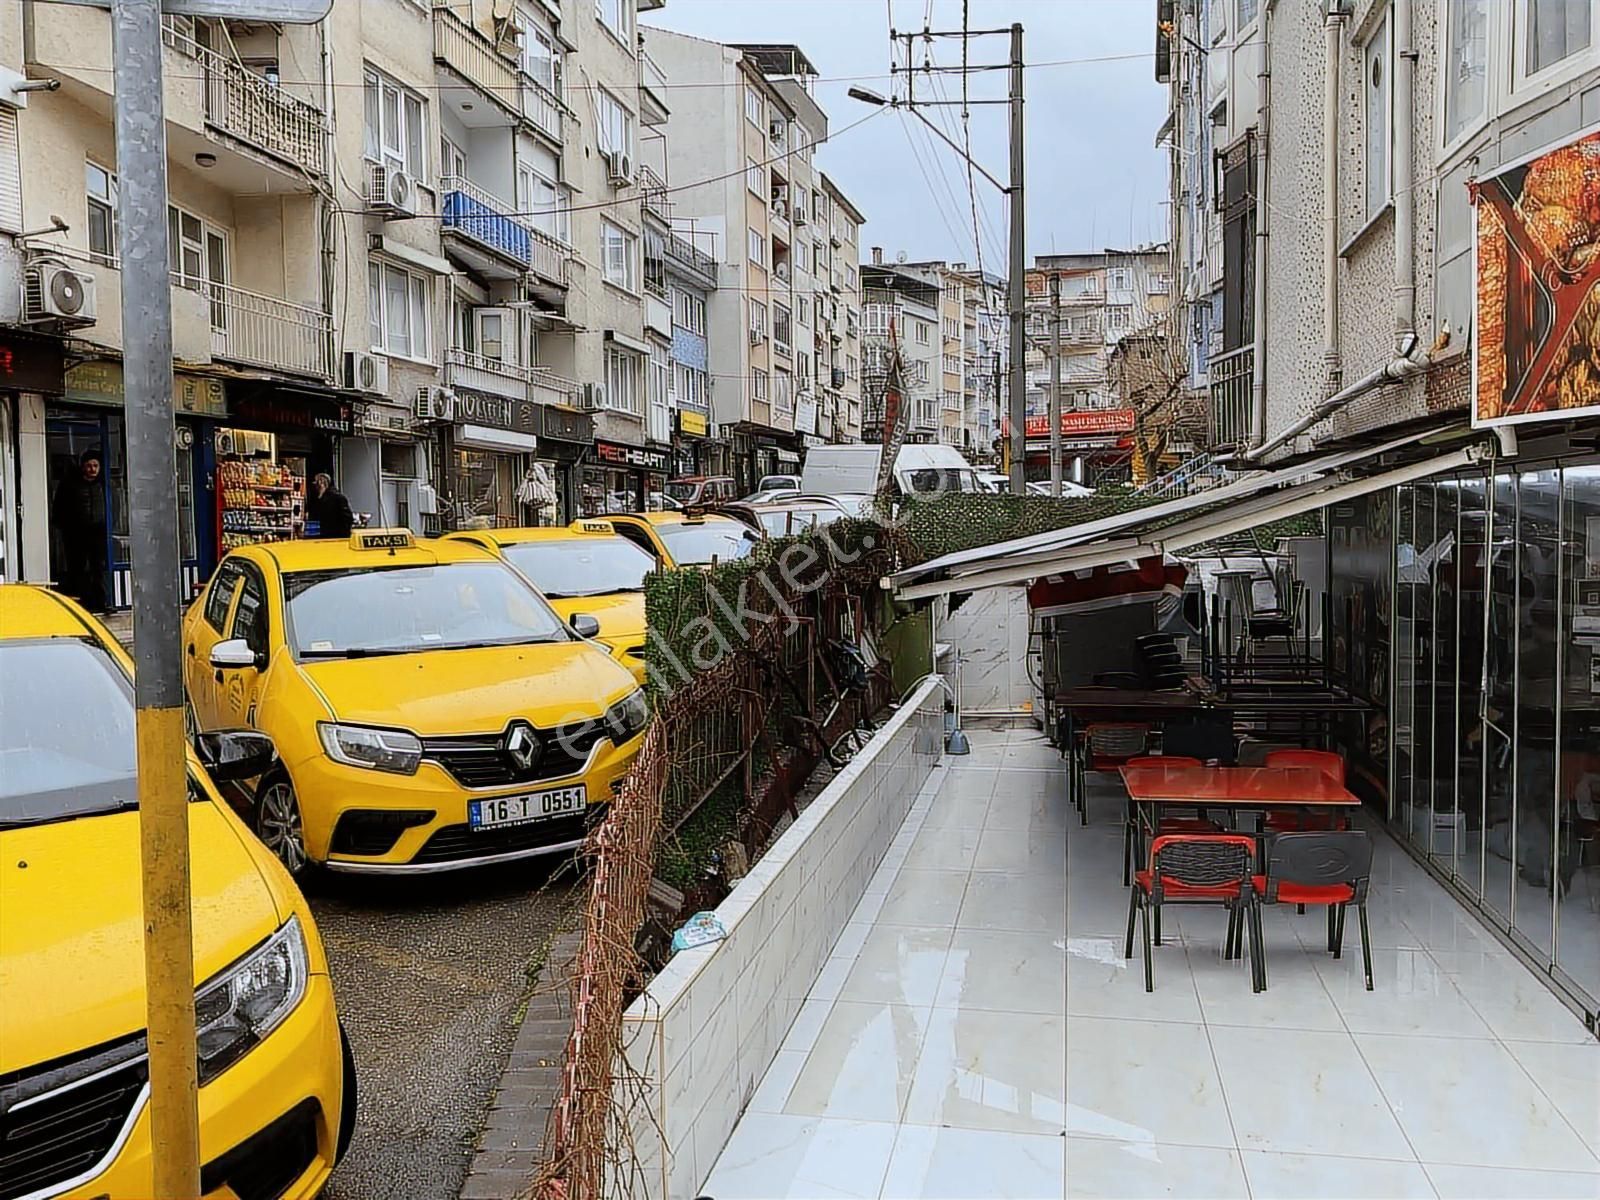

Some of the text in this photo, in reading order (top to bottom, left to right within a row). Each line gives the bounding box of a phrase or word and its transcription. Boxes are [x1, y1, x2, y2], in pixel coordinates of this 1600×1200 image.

[314, 416, 349, 432] MARKET
[488, 800, 508, 822] 16
[519, 797, 530, 817] T
[542, 789, 581, 814] 0551
